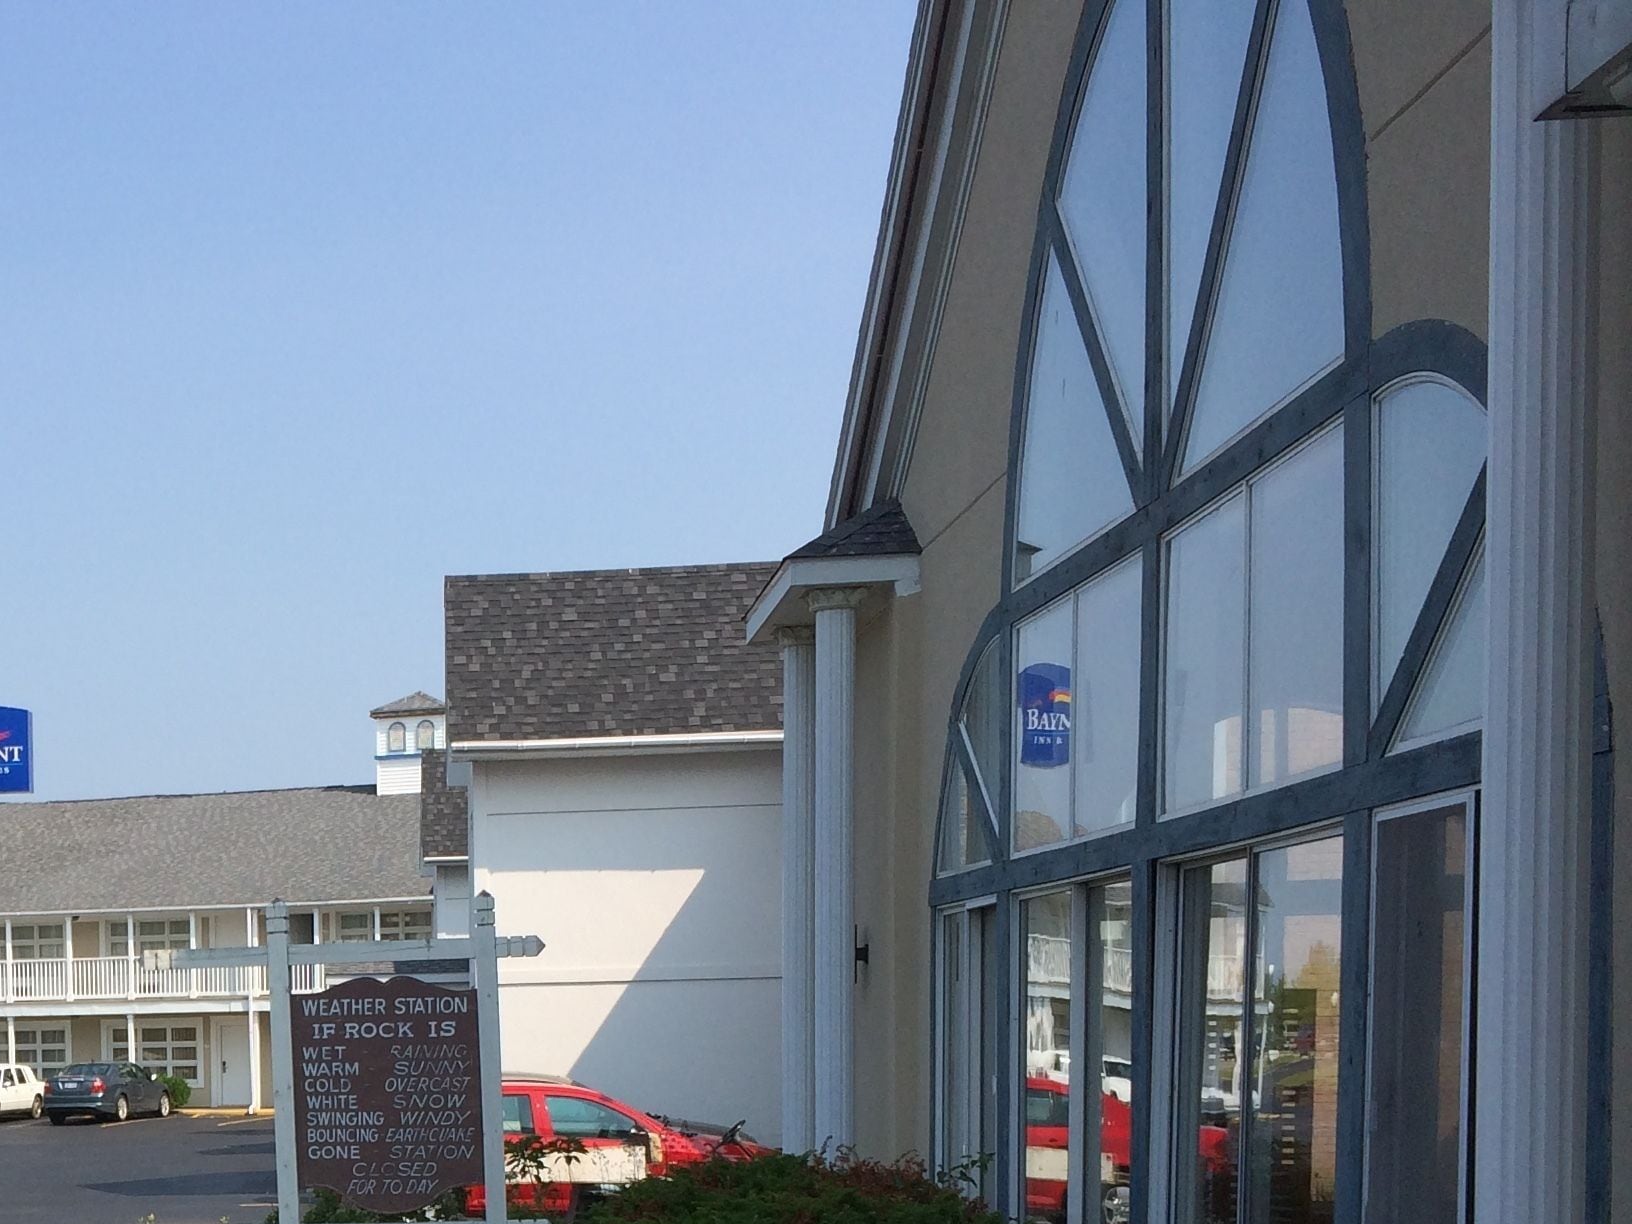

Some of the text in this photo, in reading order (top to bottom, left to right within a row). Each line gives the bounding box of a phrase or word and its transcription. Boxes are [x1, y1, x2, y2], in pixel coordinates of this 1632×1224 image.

[1033, 735, 1051, 745] INN
[302, 996, 468, 1017] WEATHER STATION
[312, 1021, 456, 1039] IF ROCK IS
[302, 1044, 467, 1060] WET RAINING
[302, 1060, 471, 1077] WARM SUNNY
[304, 1076, 472, 1093] COLD OVERCAST
[306, 1094, 467, 1110] WHITE SNOW
[306, 1110, 472, 1127] SWINGING WINDY
[307, 1128, 379, 1143] BOUNCING
[308, 1145, 476, 1160] GONE STATION
[352, 1162, 438, 1177] CLOSED
[346, 1179, 440, 1195] FOR TO DAY
